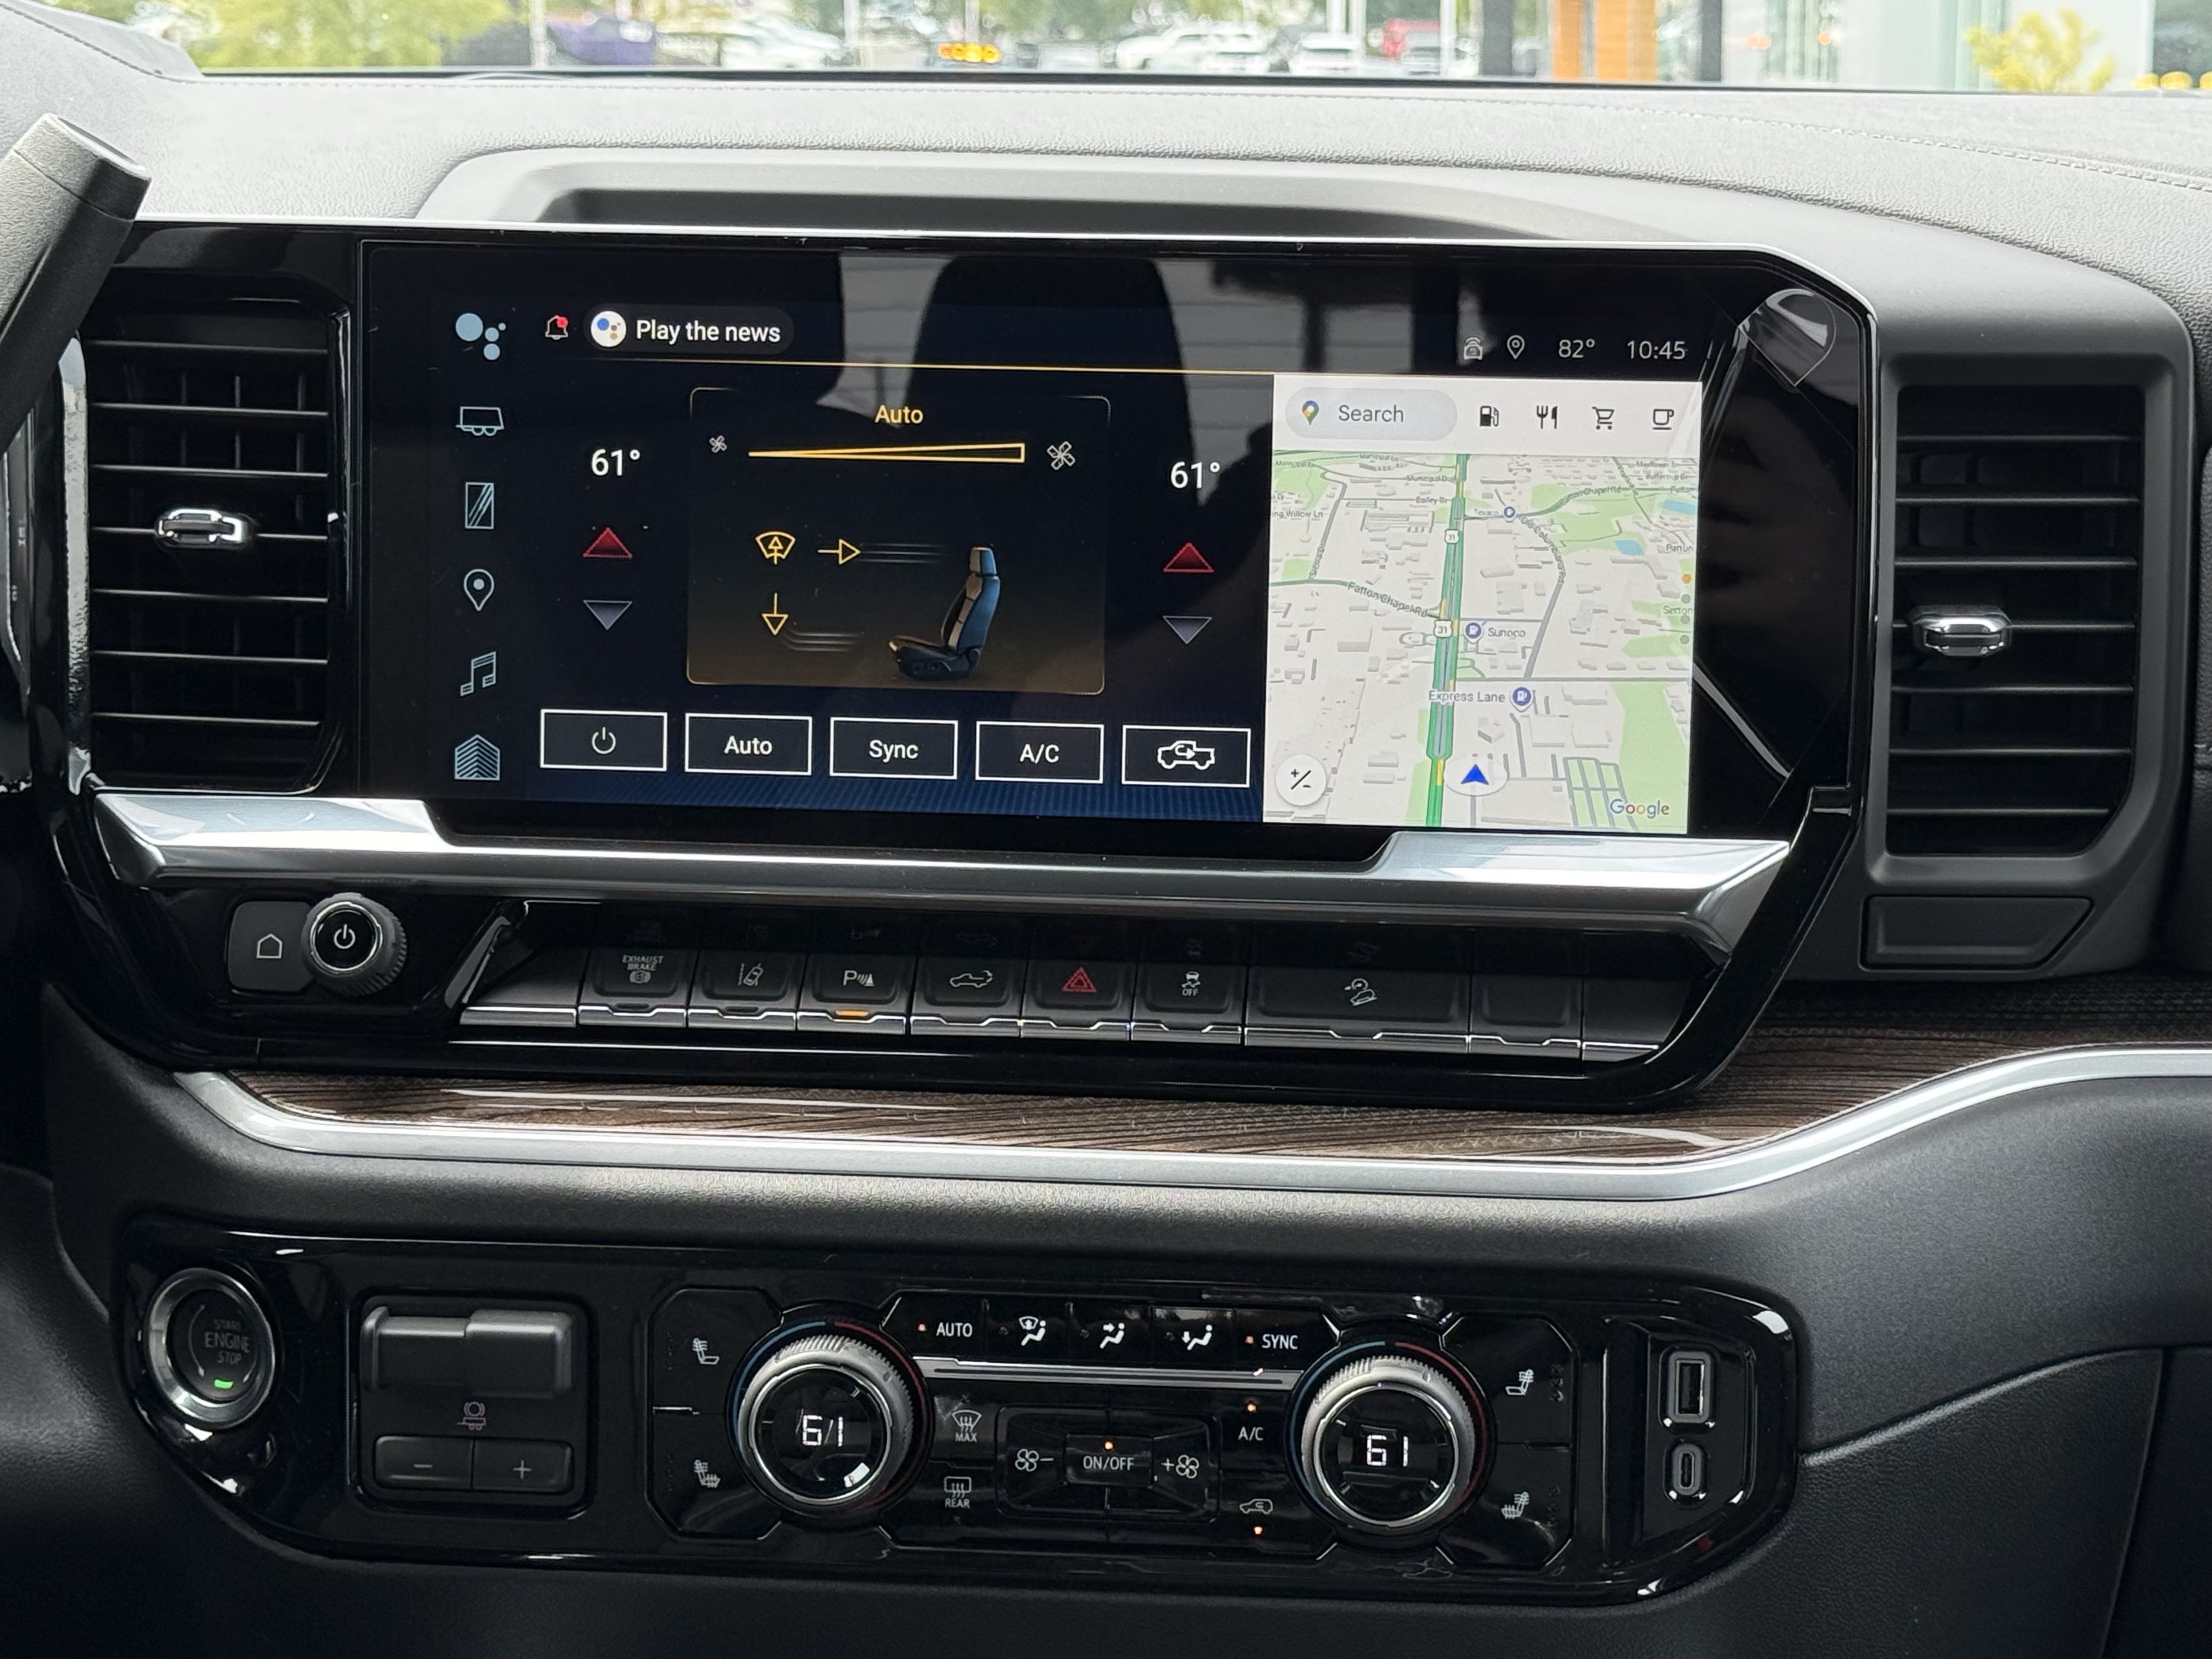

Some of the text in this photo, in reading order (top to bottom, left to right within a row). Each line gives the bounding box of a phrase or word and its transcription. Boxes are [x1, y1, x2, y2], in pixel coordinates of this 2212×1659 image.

[636, 319, 781, 345] Play the news
[1558, 338, 1596, 358] 82°
[1627, 340, 1686, 360] 10:45
[875, 405, 924, 425] Auto
[1338, 405, 1404, 424] Search
[591, 449, 641, 477] 61°
[1170, 461, 1221, 489] 61°
[1285, 509, 1311, 518] Willow
[1347, 581, 1428, 618] Patton Chapel Rd
[1438, 626, 1448, 634] 31
[1488, 627, 1526, 638] Sunoco
[1429, 690, 1506, 705] Express Lane
[724, 735, 773, 756] Auto
[868, 740, 919, 763] Sync
[1019, 744, 1060, 765] A/C
[1610, 799, 1671, 819] Google
[622, 955, 664, 964] EXHAUST
[627, 963, 657, 972] BRAKE
[1182, 988, 1199, 996] OFF
[936, 1322, 973, 1339] AUTO
[205, 1332, 250, 1353] ENGINE
[1262, 1334, 1299, 1350] SYNC
[217, 1351, 242, 1365] STOP
[802, 1414, 844, 1447] 61
[955, 1431, 978, 1443] MAX
[1238, 1426, 1264, 1442] A/C
[1366, 1434, 1409, 1468] 61
[1082, 1455, 1135, 1472] ON/OFF
[944, 1498, 970, 1509] REAR
